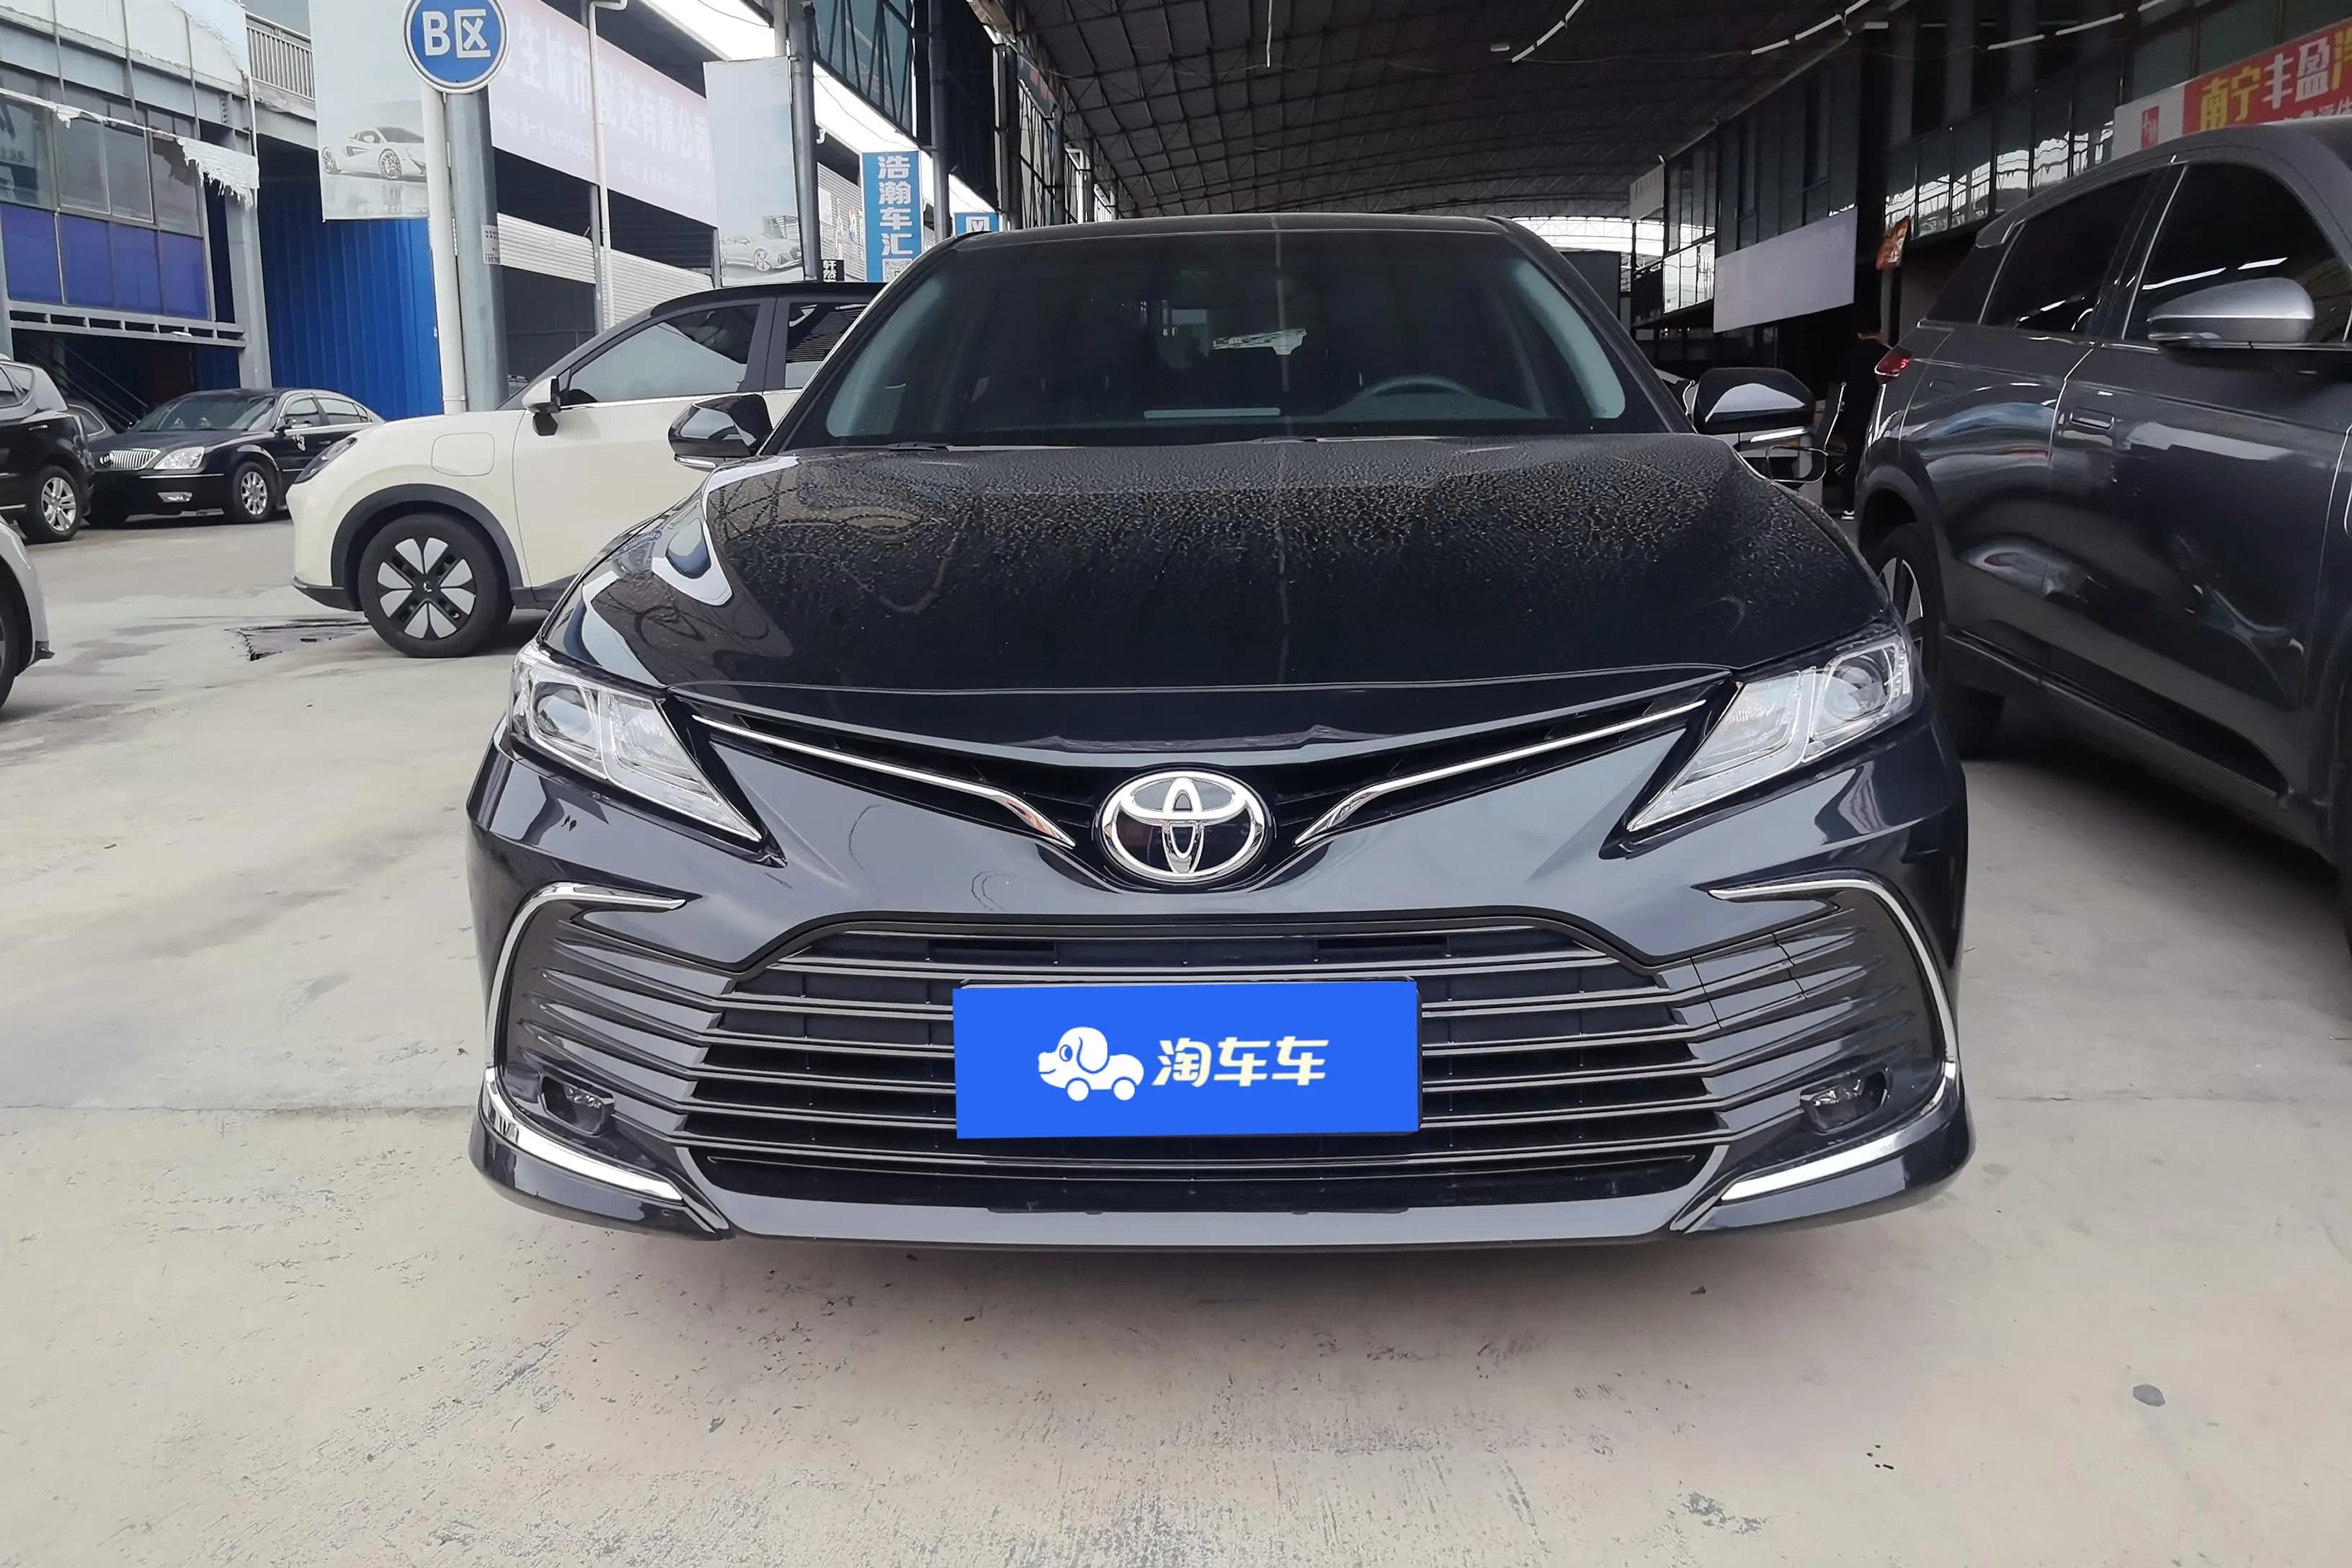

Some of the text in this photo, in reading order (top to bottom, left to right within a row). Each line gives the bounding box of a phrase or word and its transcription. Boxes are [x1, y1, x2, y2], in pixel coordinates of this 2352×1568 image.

[422, 9, 491, 58] B区
[877, 155, 914, 257] 浩瀚车汇
[822, 260, 837, 283] 轩然
